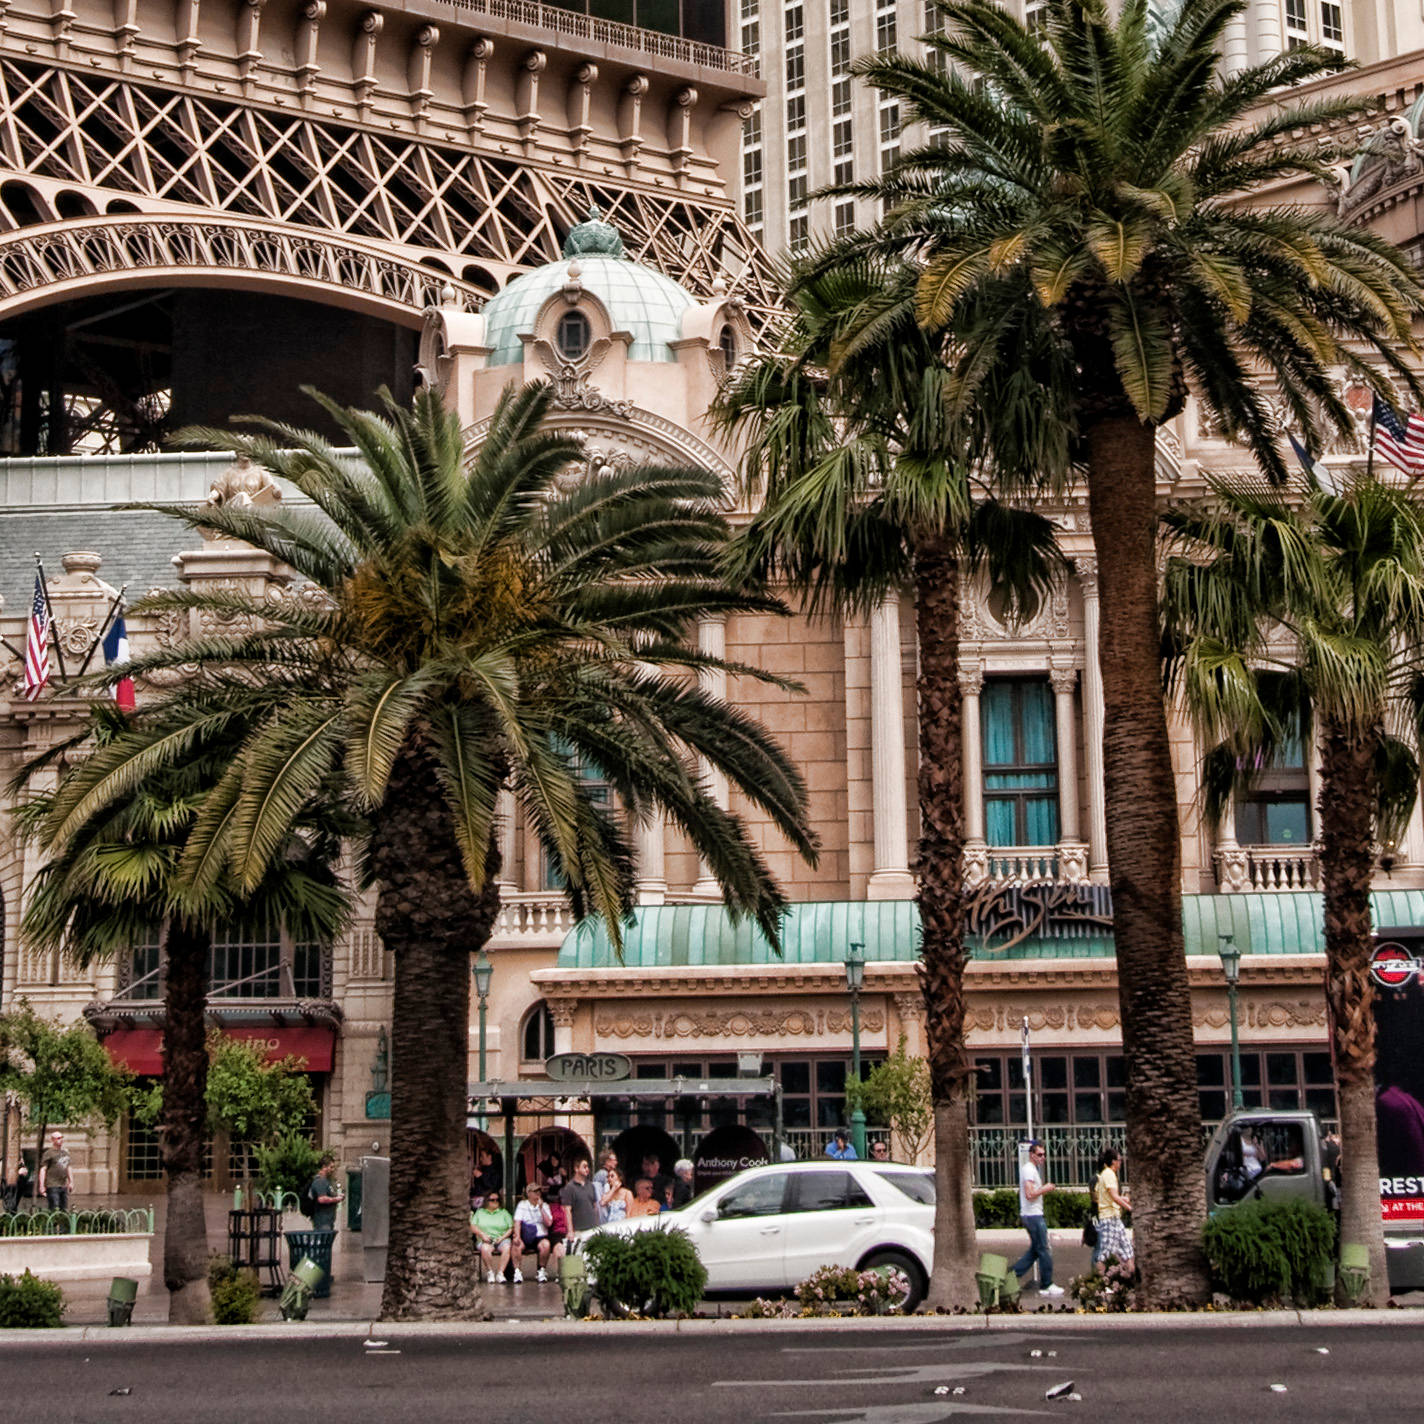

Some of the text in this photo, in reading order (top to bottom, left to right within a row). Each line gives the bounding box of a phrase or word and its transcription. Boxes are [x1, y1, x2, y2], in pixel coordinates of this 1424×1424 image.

[561, 1057, 617, 1078] PARIS
[697, 1157, 737, 1169] Anthony
[1392, 1202, 1405, 1212] AT
[1406, 1202, 1424, 1211] THE
